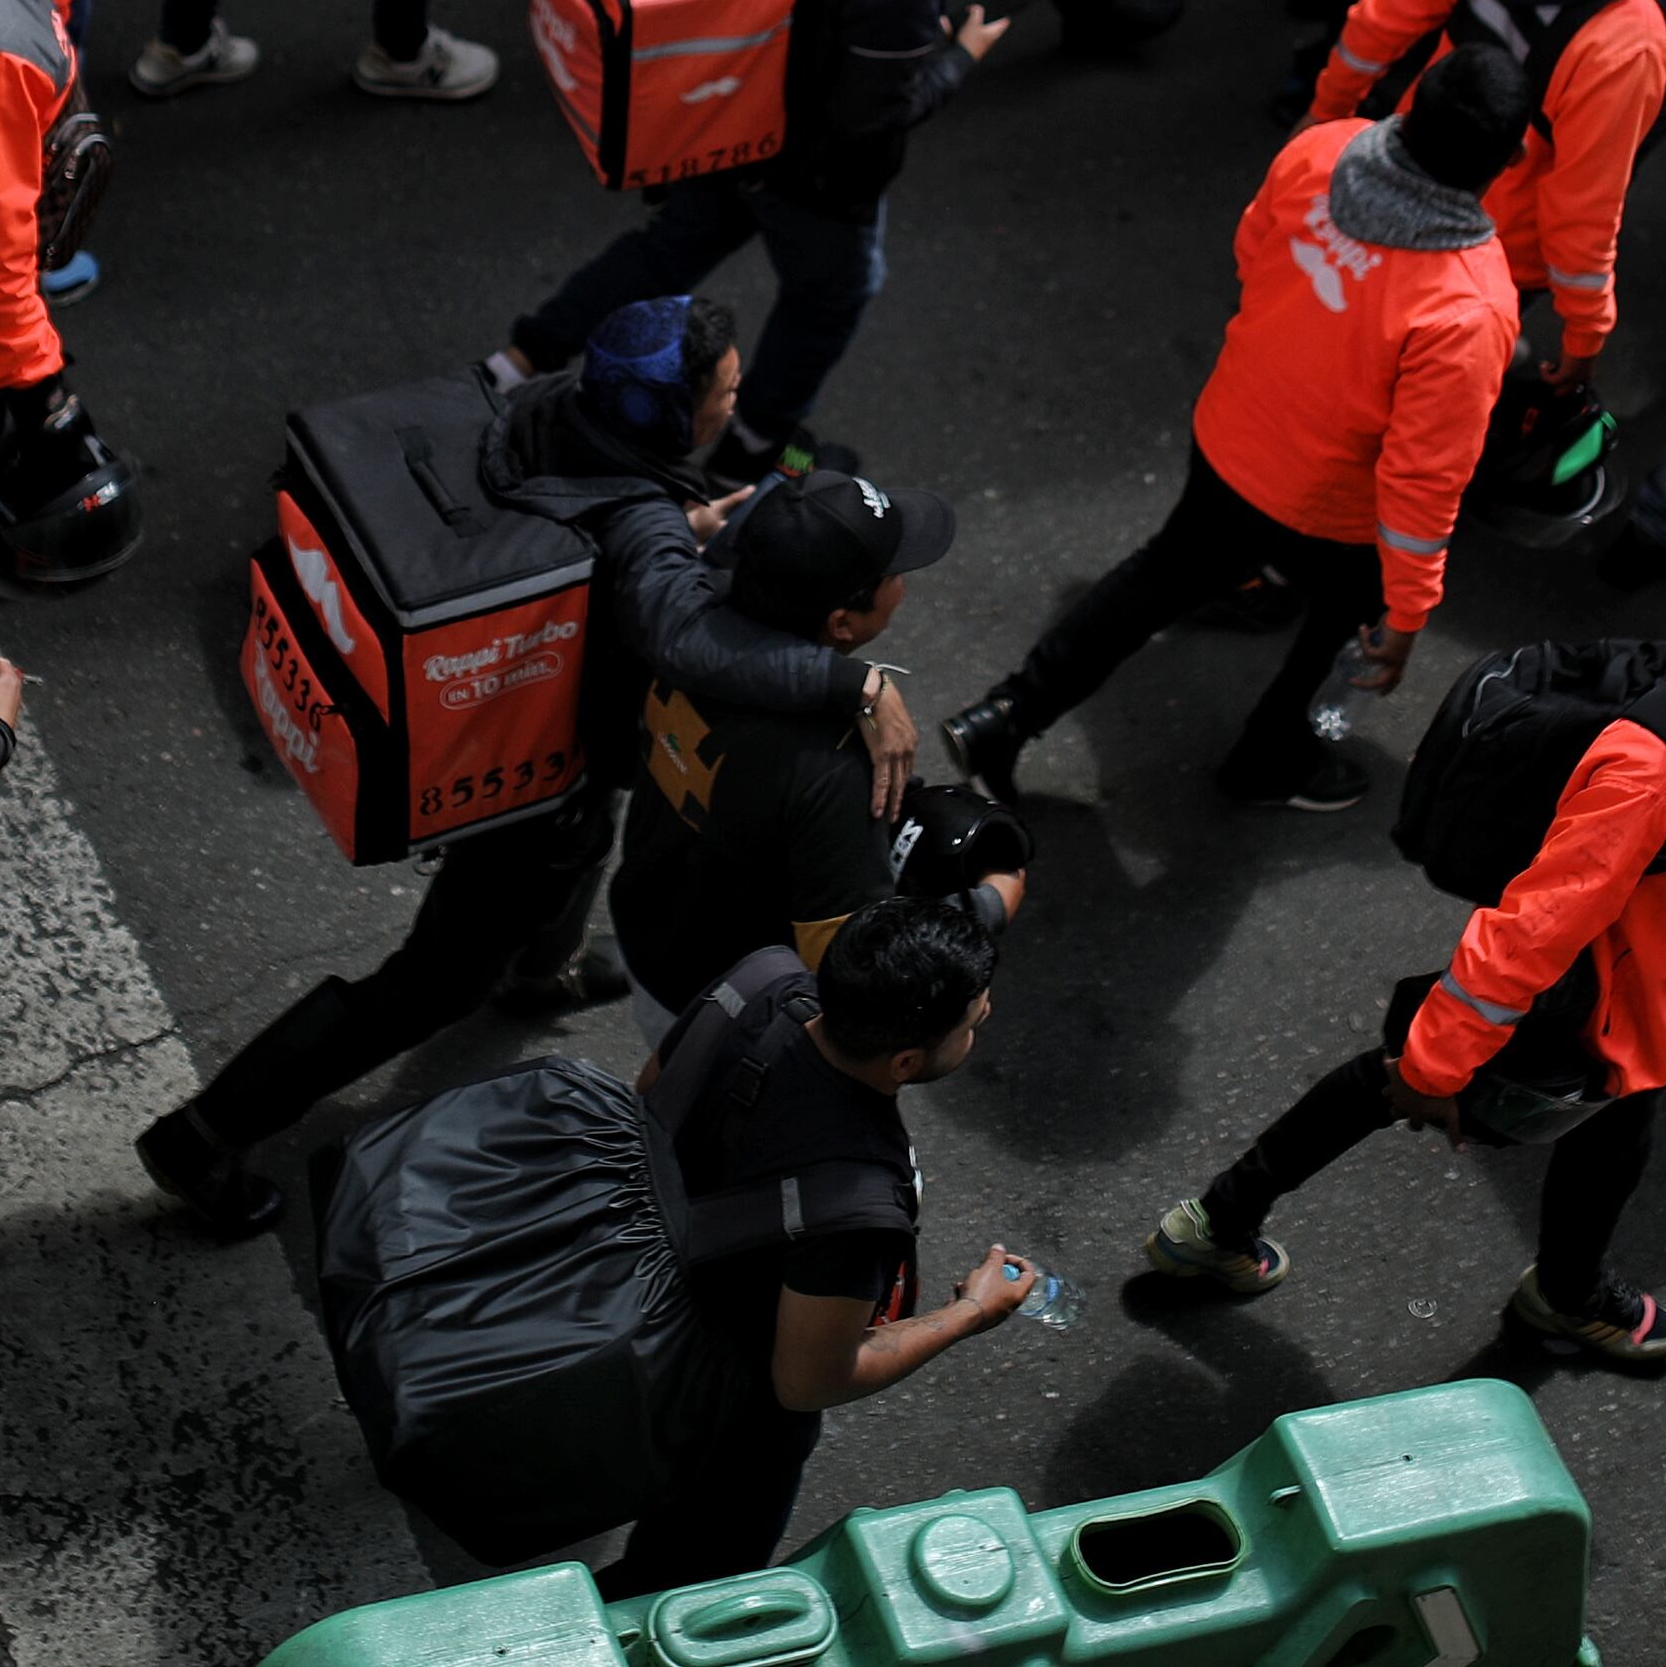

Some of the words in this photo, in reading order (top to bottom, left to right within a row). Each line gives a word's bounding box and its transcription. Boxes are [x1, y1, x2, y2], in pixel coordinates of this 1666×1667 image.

[422, 637, 503, 683] Rappi
[504, 619, 581, 659] Turbo
[446, 686, 471, 704] EN
[471, 676, 502, 700] 10
